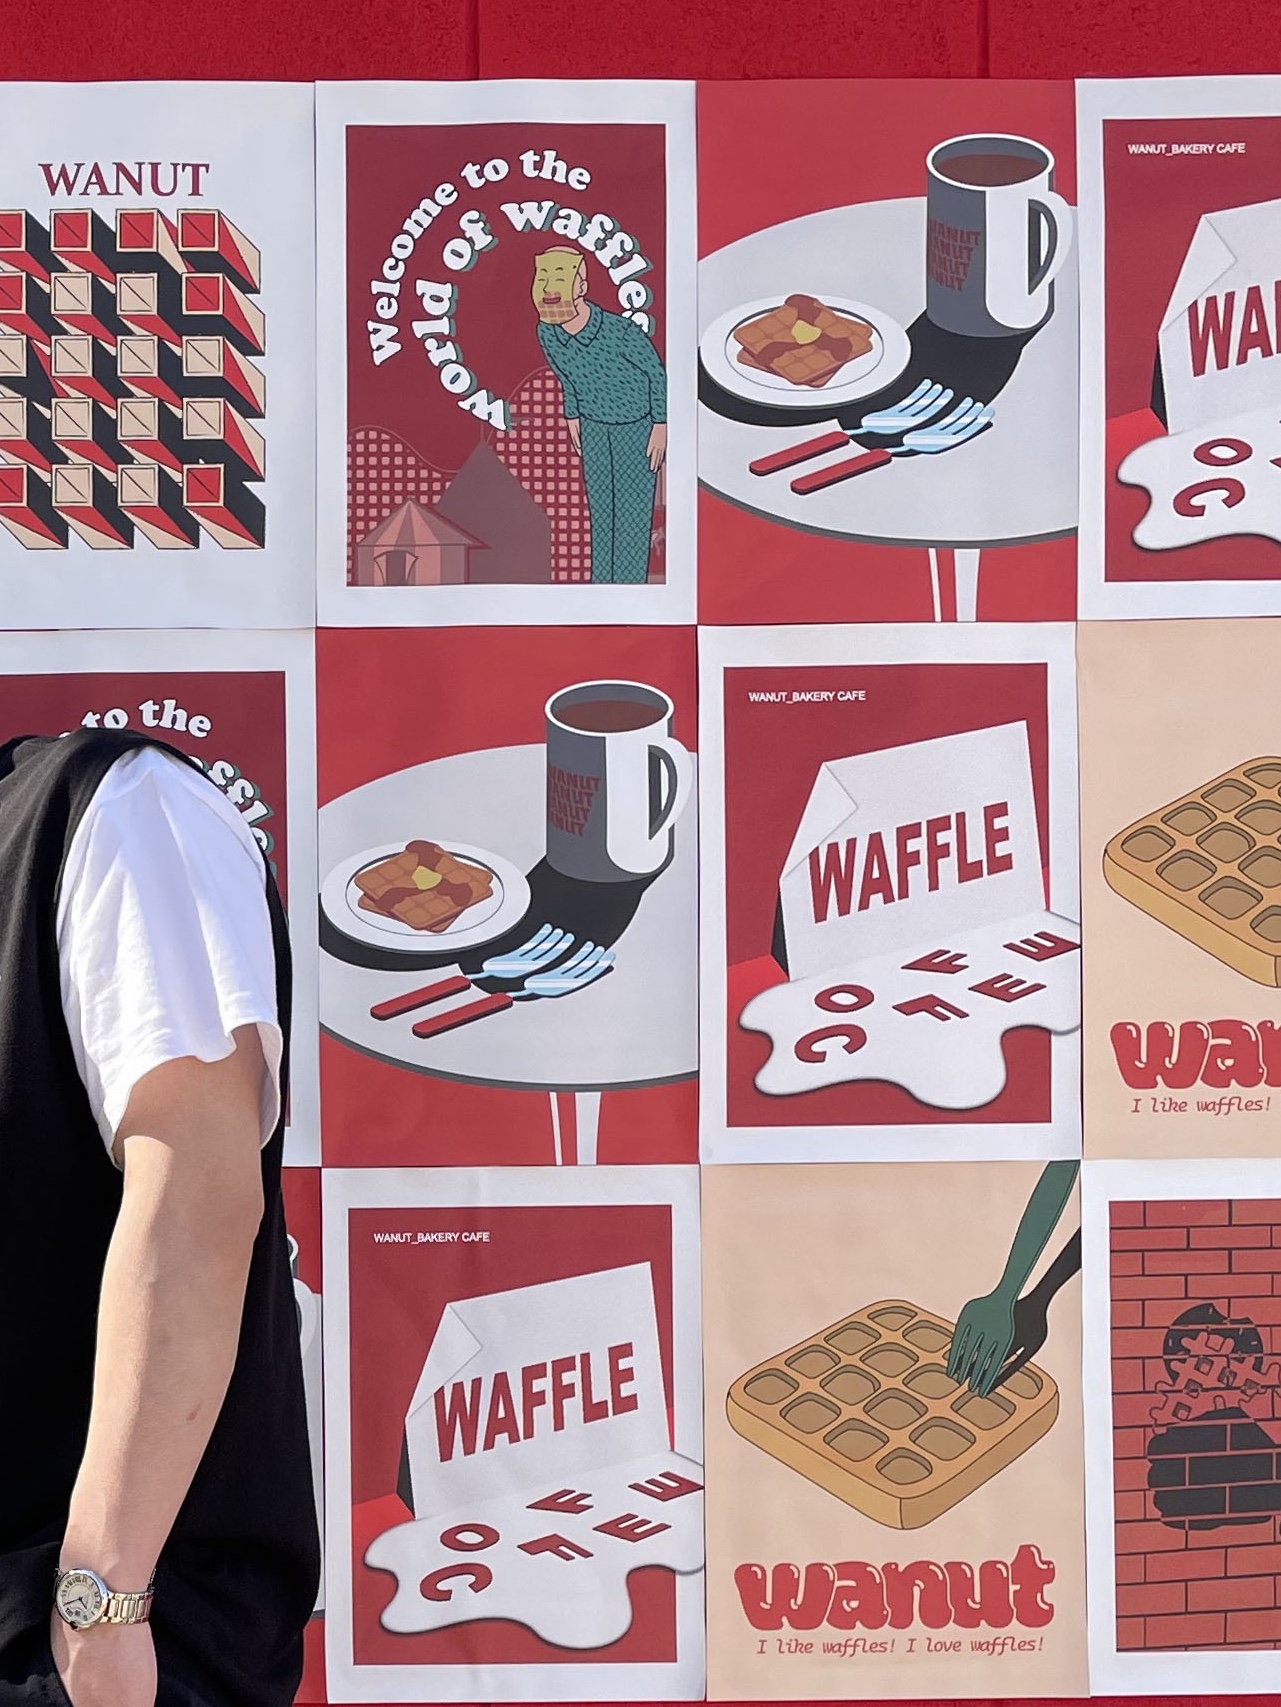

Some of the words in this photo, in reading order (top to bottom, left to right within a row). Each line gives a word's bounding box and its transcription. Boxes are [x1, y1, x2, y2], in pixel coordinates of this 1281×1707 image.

[1216, 142, 1246, 154] CAFE
[38, 162, 210, 196] WANUT
[367, 182, 458, 366] Welcome
[461, 158, 509, 188] to
[519, 150, 591, 190] the
[1187, 279, 1281, 378] WA
[748, 690, 836, 704] WANUT_BAKERY
[837, 690, 866, 701] CAFE
[138, 699, 212, 738] the
[809, 800, 1013, 924] WAFFLE
[1131, 1098, 1142, 1113] I
[1152, 1097, 1188, 1113] like
[1196, 1096, 1271, 1116] waffles!
[374, 1232, 458, 1244] WANUT_BAKERY
[461, 1232, 490, 1242] CAFE
[433, 1342, 638, 1462] WAFFLE
[734, 1544, 1056, 1630] wanut
[757, 1639, 768, 1654] I
[777, 1638, 814, 1654] like
[822, 1638, 896, 1658] waffles!
[906, 1638, 917, 1652] I
[926, 1637, 962, 1652] love
[970, 1636, 1044, 1656] waffles!
